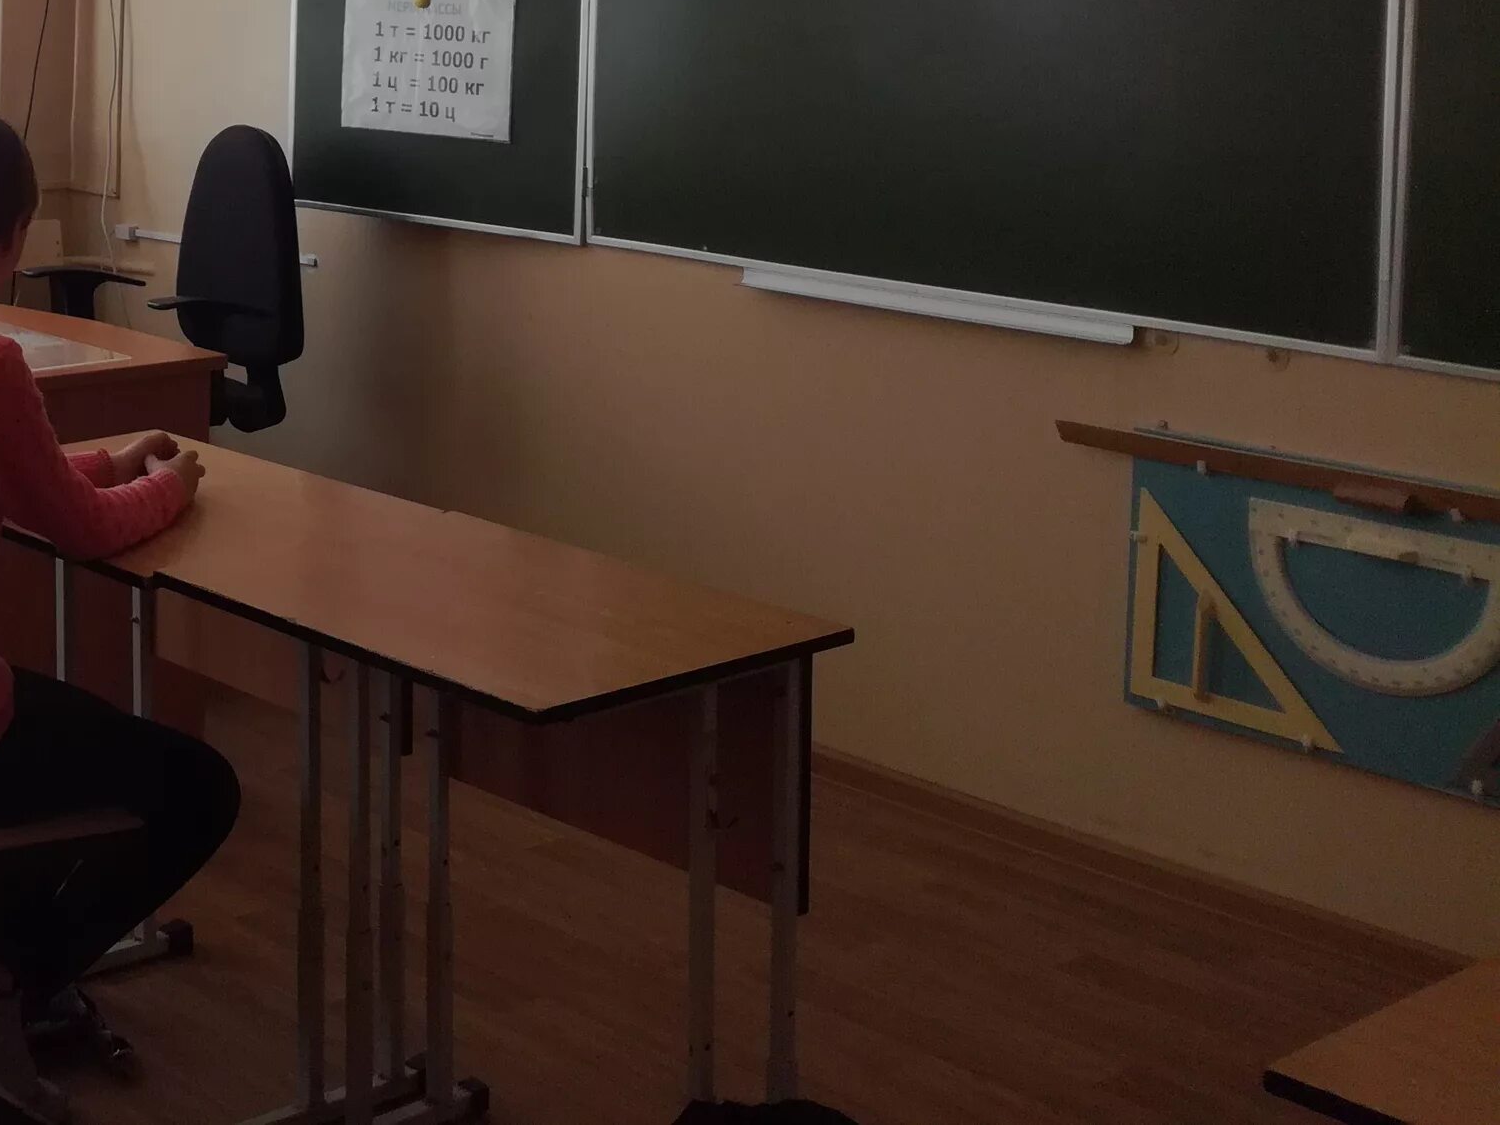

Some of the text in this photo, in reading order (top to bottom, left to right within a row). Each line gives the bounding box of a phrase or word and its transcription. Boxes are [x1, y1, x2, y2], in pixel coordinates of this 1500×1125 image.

[388, 0, 413, 13] МЕР
[375, 21, 384, 37] 1
[424, 24, 465, 42] 1000
[374, 46, 382, 62] 1
[389, 51, 408, 63] кг
[431, 50, 473, 69] 1000
[480, 58, 489, 69] г
[372, 71, 381, 88] 1
[428, 75, 458, 94] 100
[466, 83, 484, 96] кг
[371, 96, 379, 112] 1
[386, 101, 395, 114] т
[419, 101, 439, 118] 10
[445, 107, 455, 122] ц
